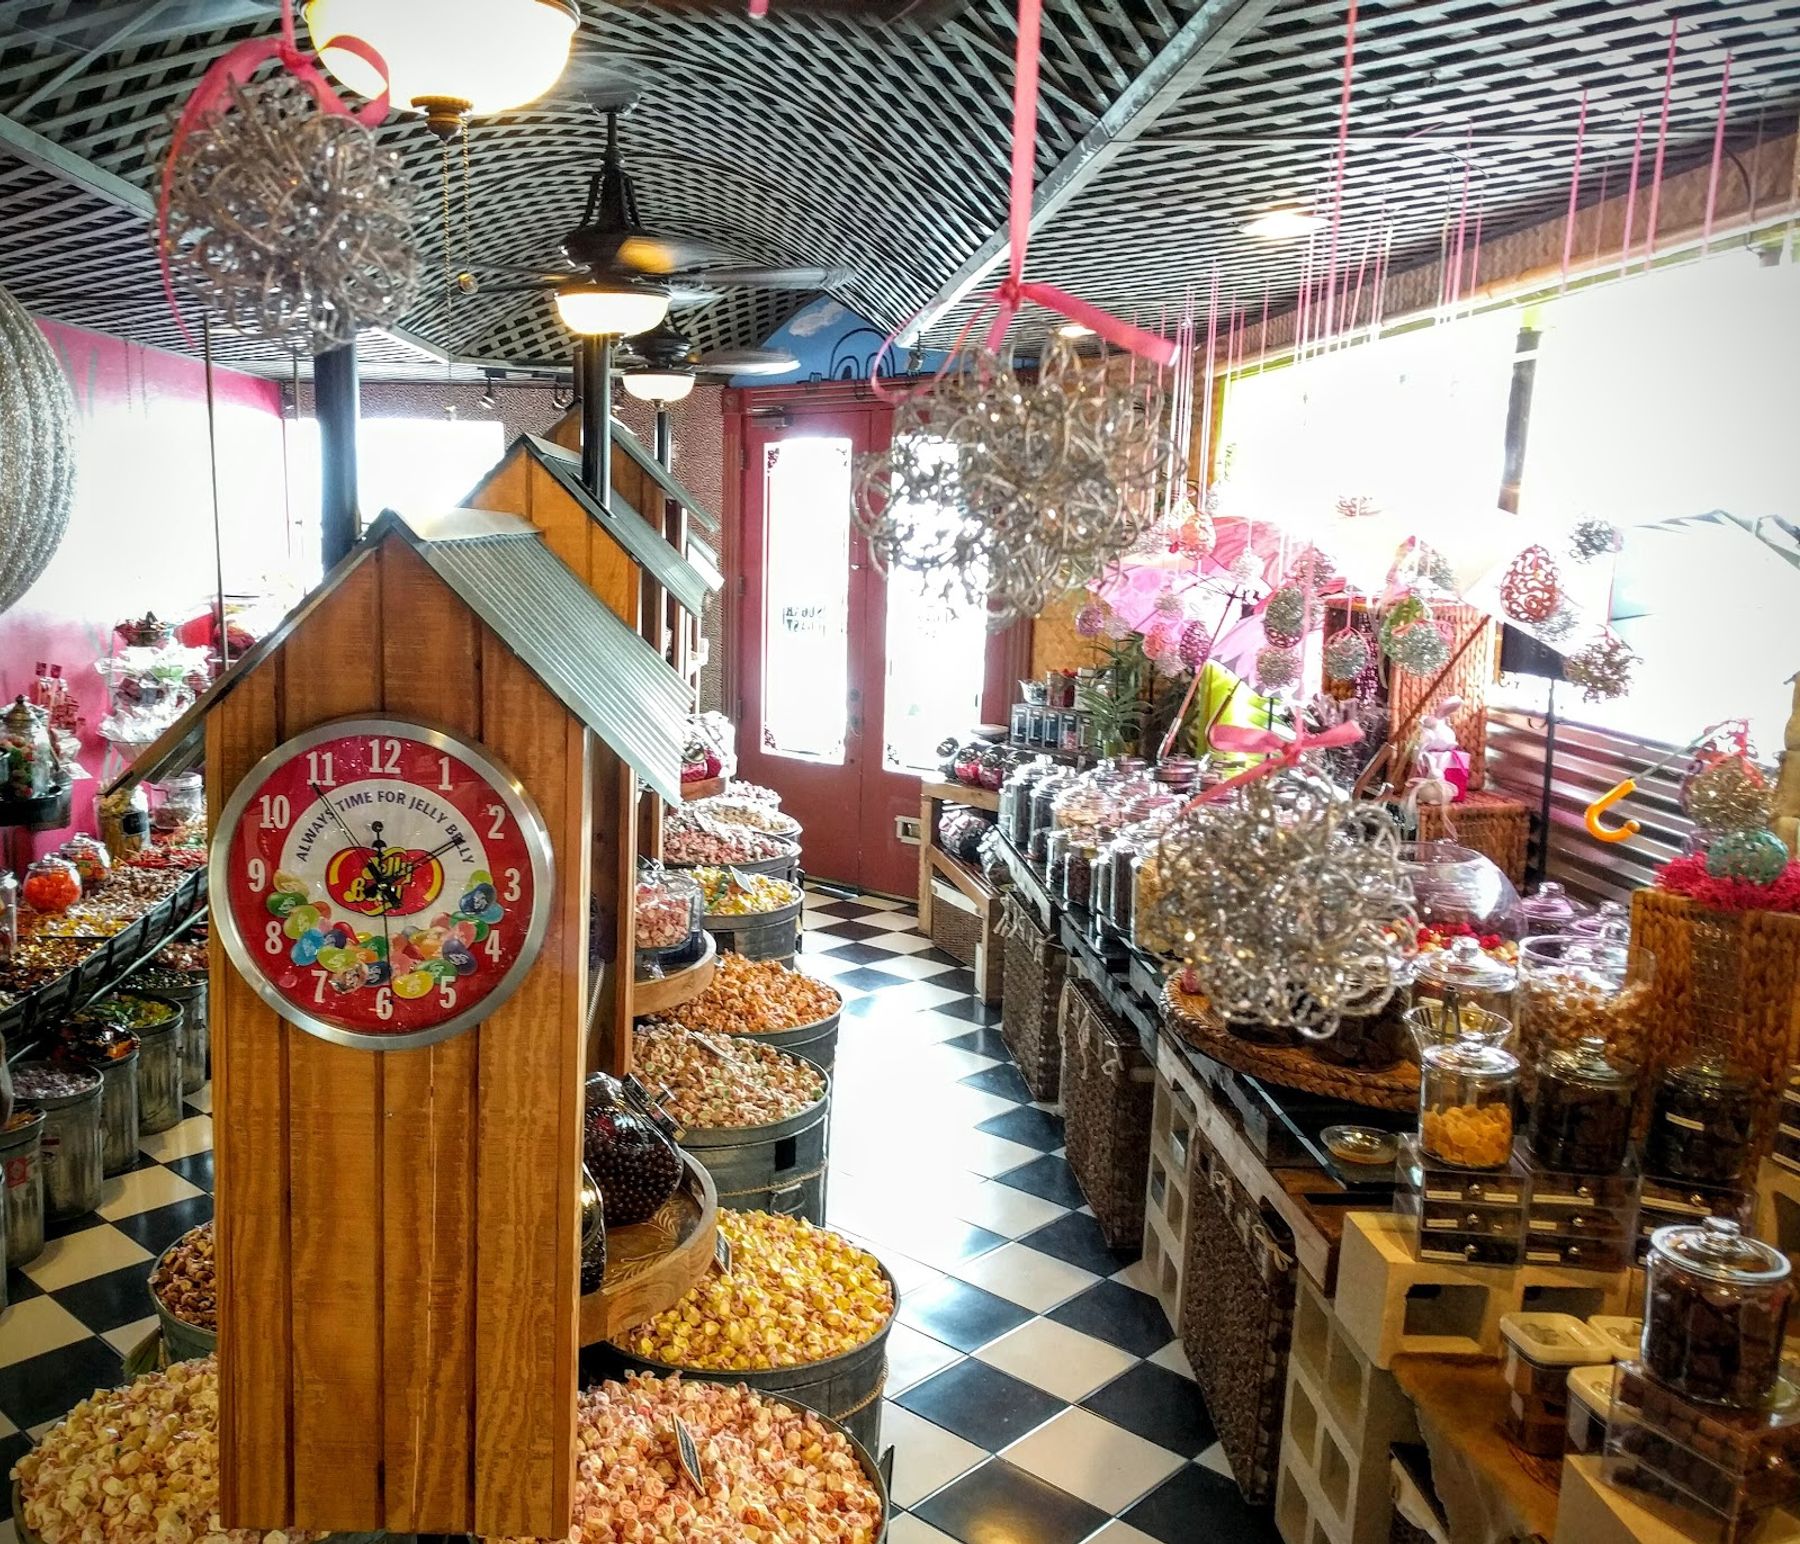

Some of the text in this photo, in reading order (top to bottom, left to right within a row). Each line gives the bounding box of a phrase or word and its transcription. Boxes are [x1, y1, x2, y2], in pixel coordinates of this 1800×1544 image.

[305, 752, 337, 786] 11
[368, 739, 402, 774] 12
[438, 757, 454, 791] 1
[259, 795, 291, 829] 10
[296, 808, 335, 862] ALWAYS
[335, 792, 374, 812] TIME
[377, 791, 407, 805] FOR
[408, 796, 449, 823] JELLY
[488, 805, 505, 840] 2
[248, 858, 265, 892] 9
[504, 868, 521, 902] 3
[265, 920, 283, 954] 8
[484, 929, 503, 963] 4
[310, 969, 327, 1003] 7
[375, 986, 394, 1020] 6
[439, 975, 457, 1009] 5
